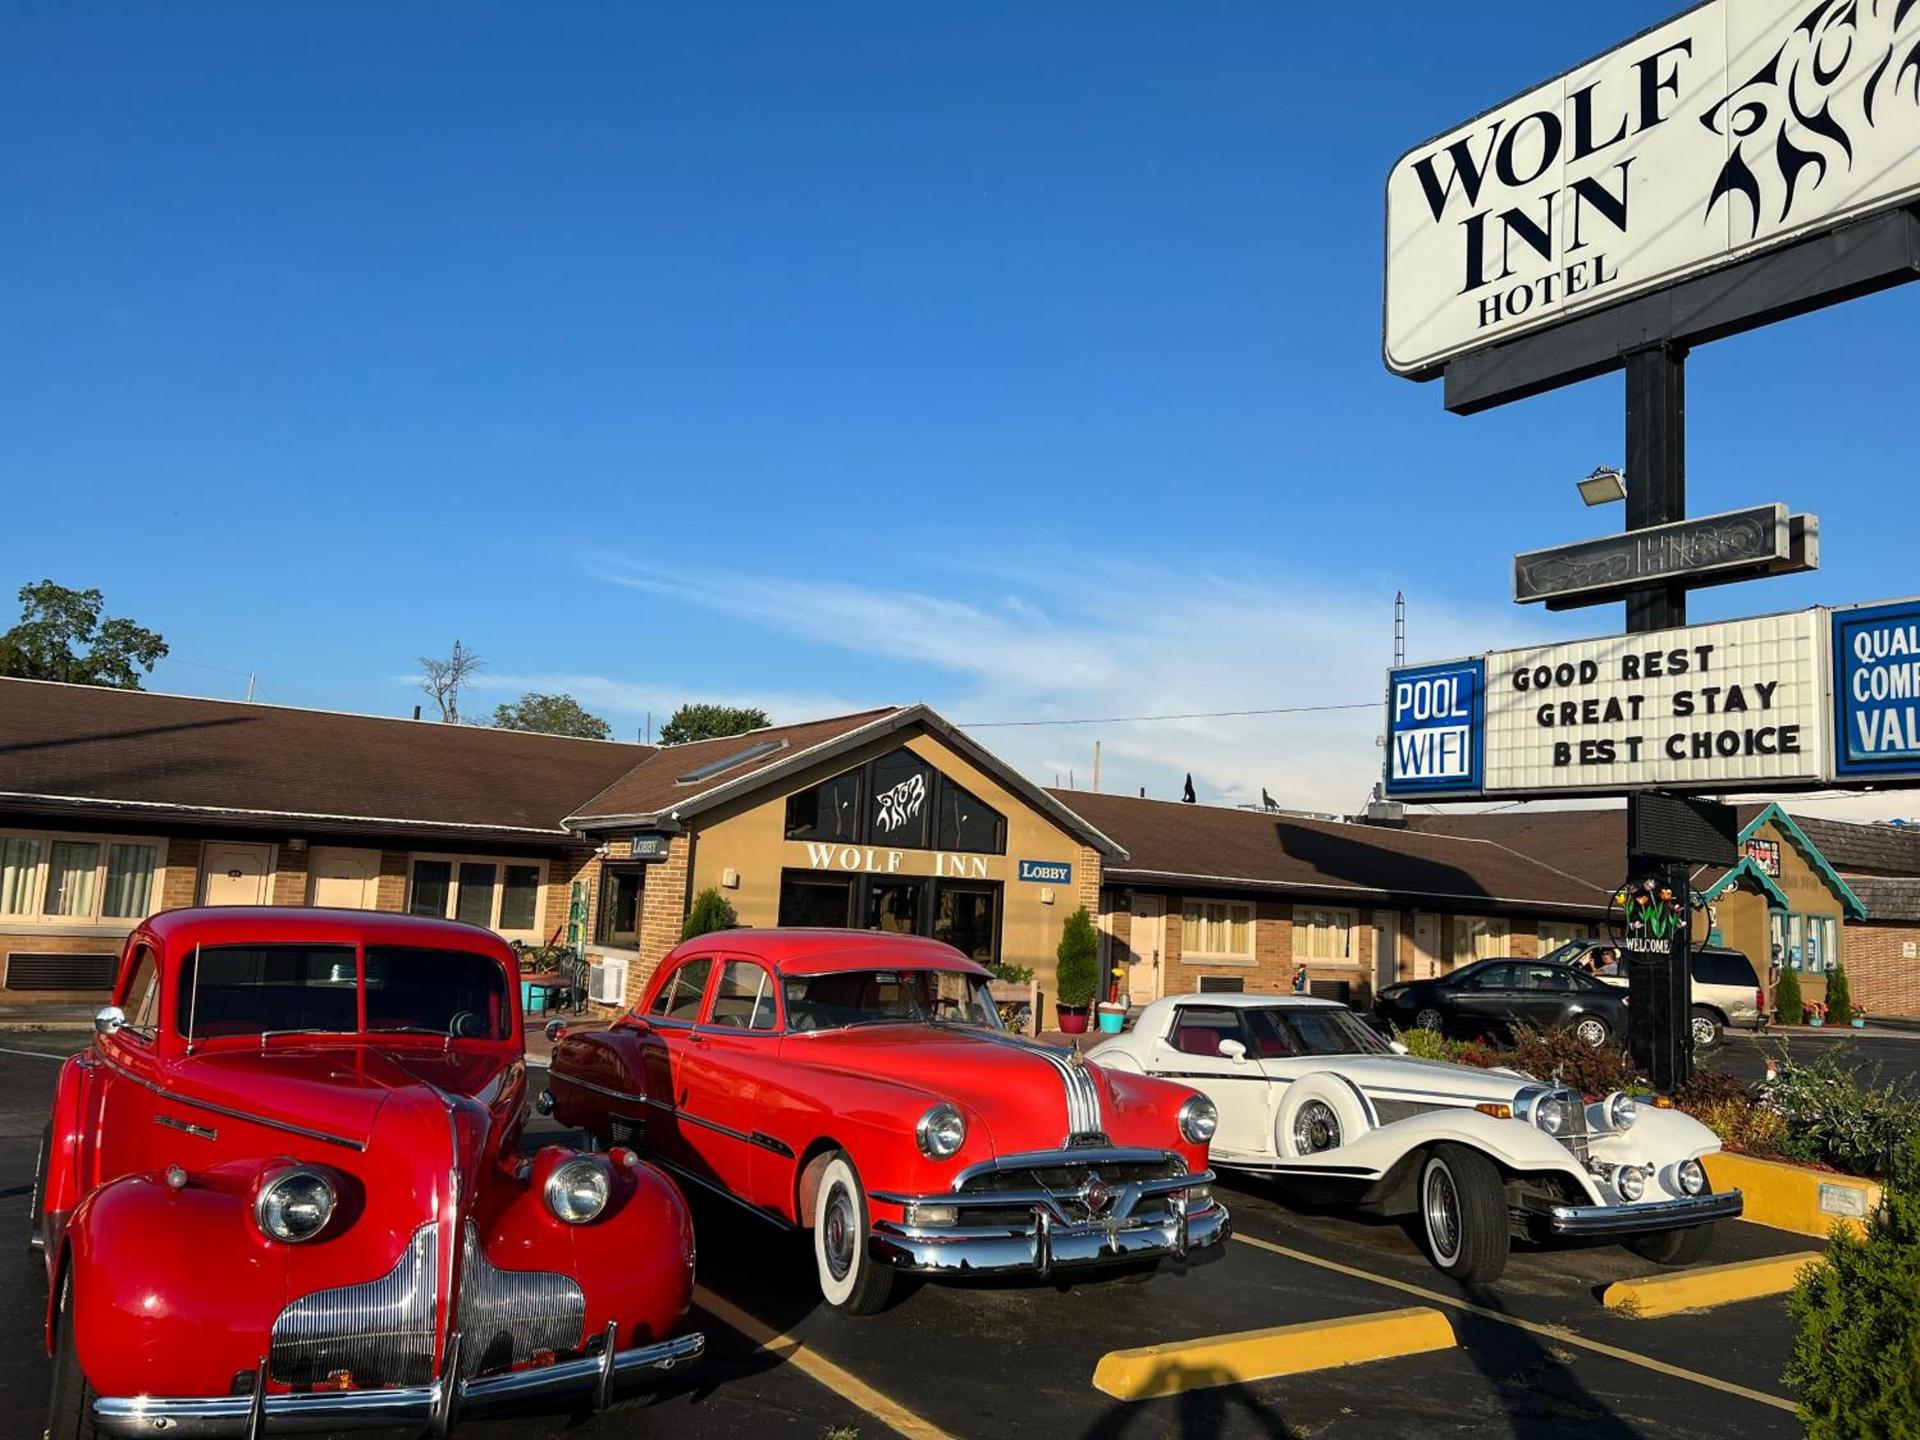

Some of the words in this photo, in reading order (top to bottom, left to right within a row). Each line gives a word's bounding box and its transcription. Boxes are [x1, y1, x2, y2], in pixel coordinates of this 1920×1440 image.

[1411, 38, 1692, 223] WOLF
[1457, 157, 1637, 295] INN
[1477, 253, 1618, 328] HOTEL
[1513, 660, 1598, 692] GOOD
[1622, 645, 1714, 681] REST
[1396, 678, 1468, 722] POOL
[1537, 694, 1644, 727] GREAT
[1672, 681, 1778, 717] STAY
[1396, 731, 1465, 776] WIFI
[1554, 736, 1643, 766] BEST
[1665, 725, 1800, 760] CHOICE
[806, 843, 903, 873] WOLF
[934, 853, 989, 878] INN
[1022, 863, 1068, 881] LOBBY
[1626, 938, 1670, 954] WELCOME
